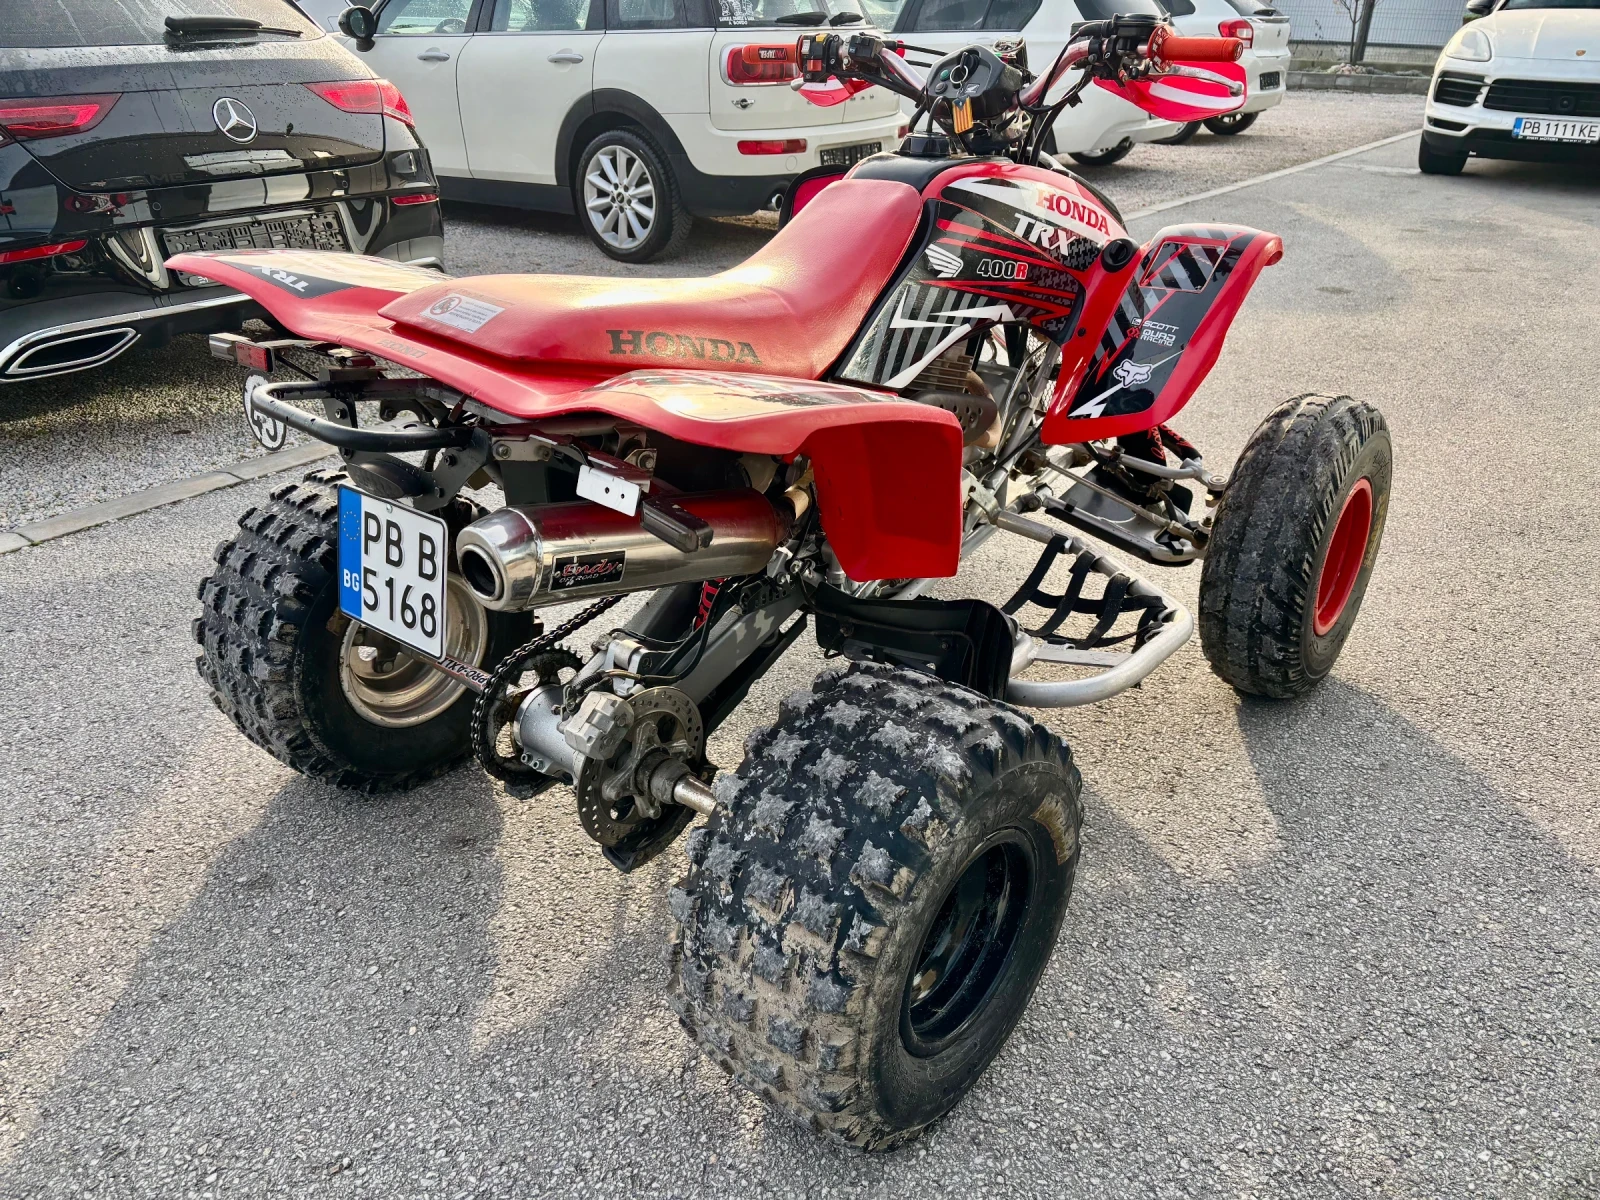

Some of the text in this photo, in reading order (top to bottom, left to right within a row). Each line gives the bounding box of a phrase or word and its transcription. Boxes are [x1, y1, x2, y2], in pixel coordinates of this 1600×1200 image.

[1522, 121, 1541, 134] PB
[1035, 188, 1111, 237] HONDA
[1013, 212, 1077, 257] TRX
[251, 265, 309, 292] TRX
[976, 257, 1029, 280] 400R
[1142, 320, 1180, 333] SCOTT
[1142, 328, 1177, 342] QUAD
[605, 329, 763, 365] HONDA
[1140, 334, 1175, 347] RACING
[364, 510, 438, 582] PB B
[343, 568, 360, 592] BG
[362, 565, 438, 639] 5168
